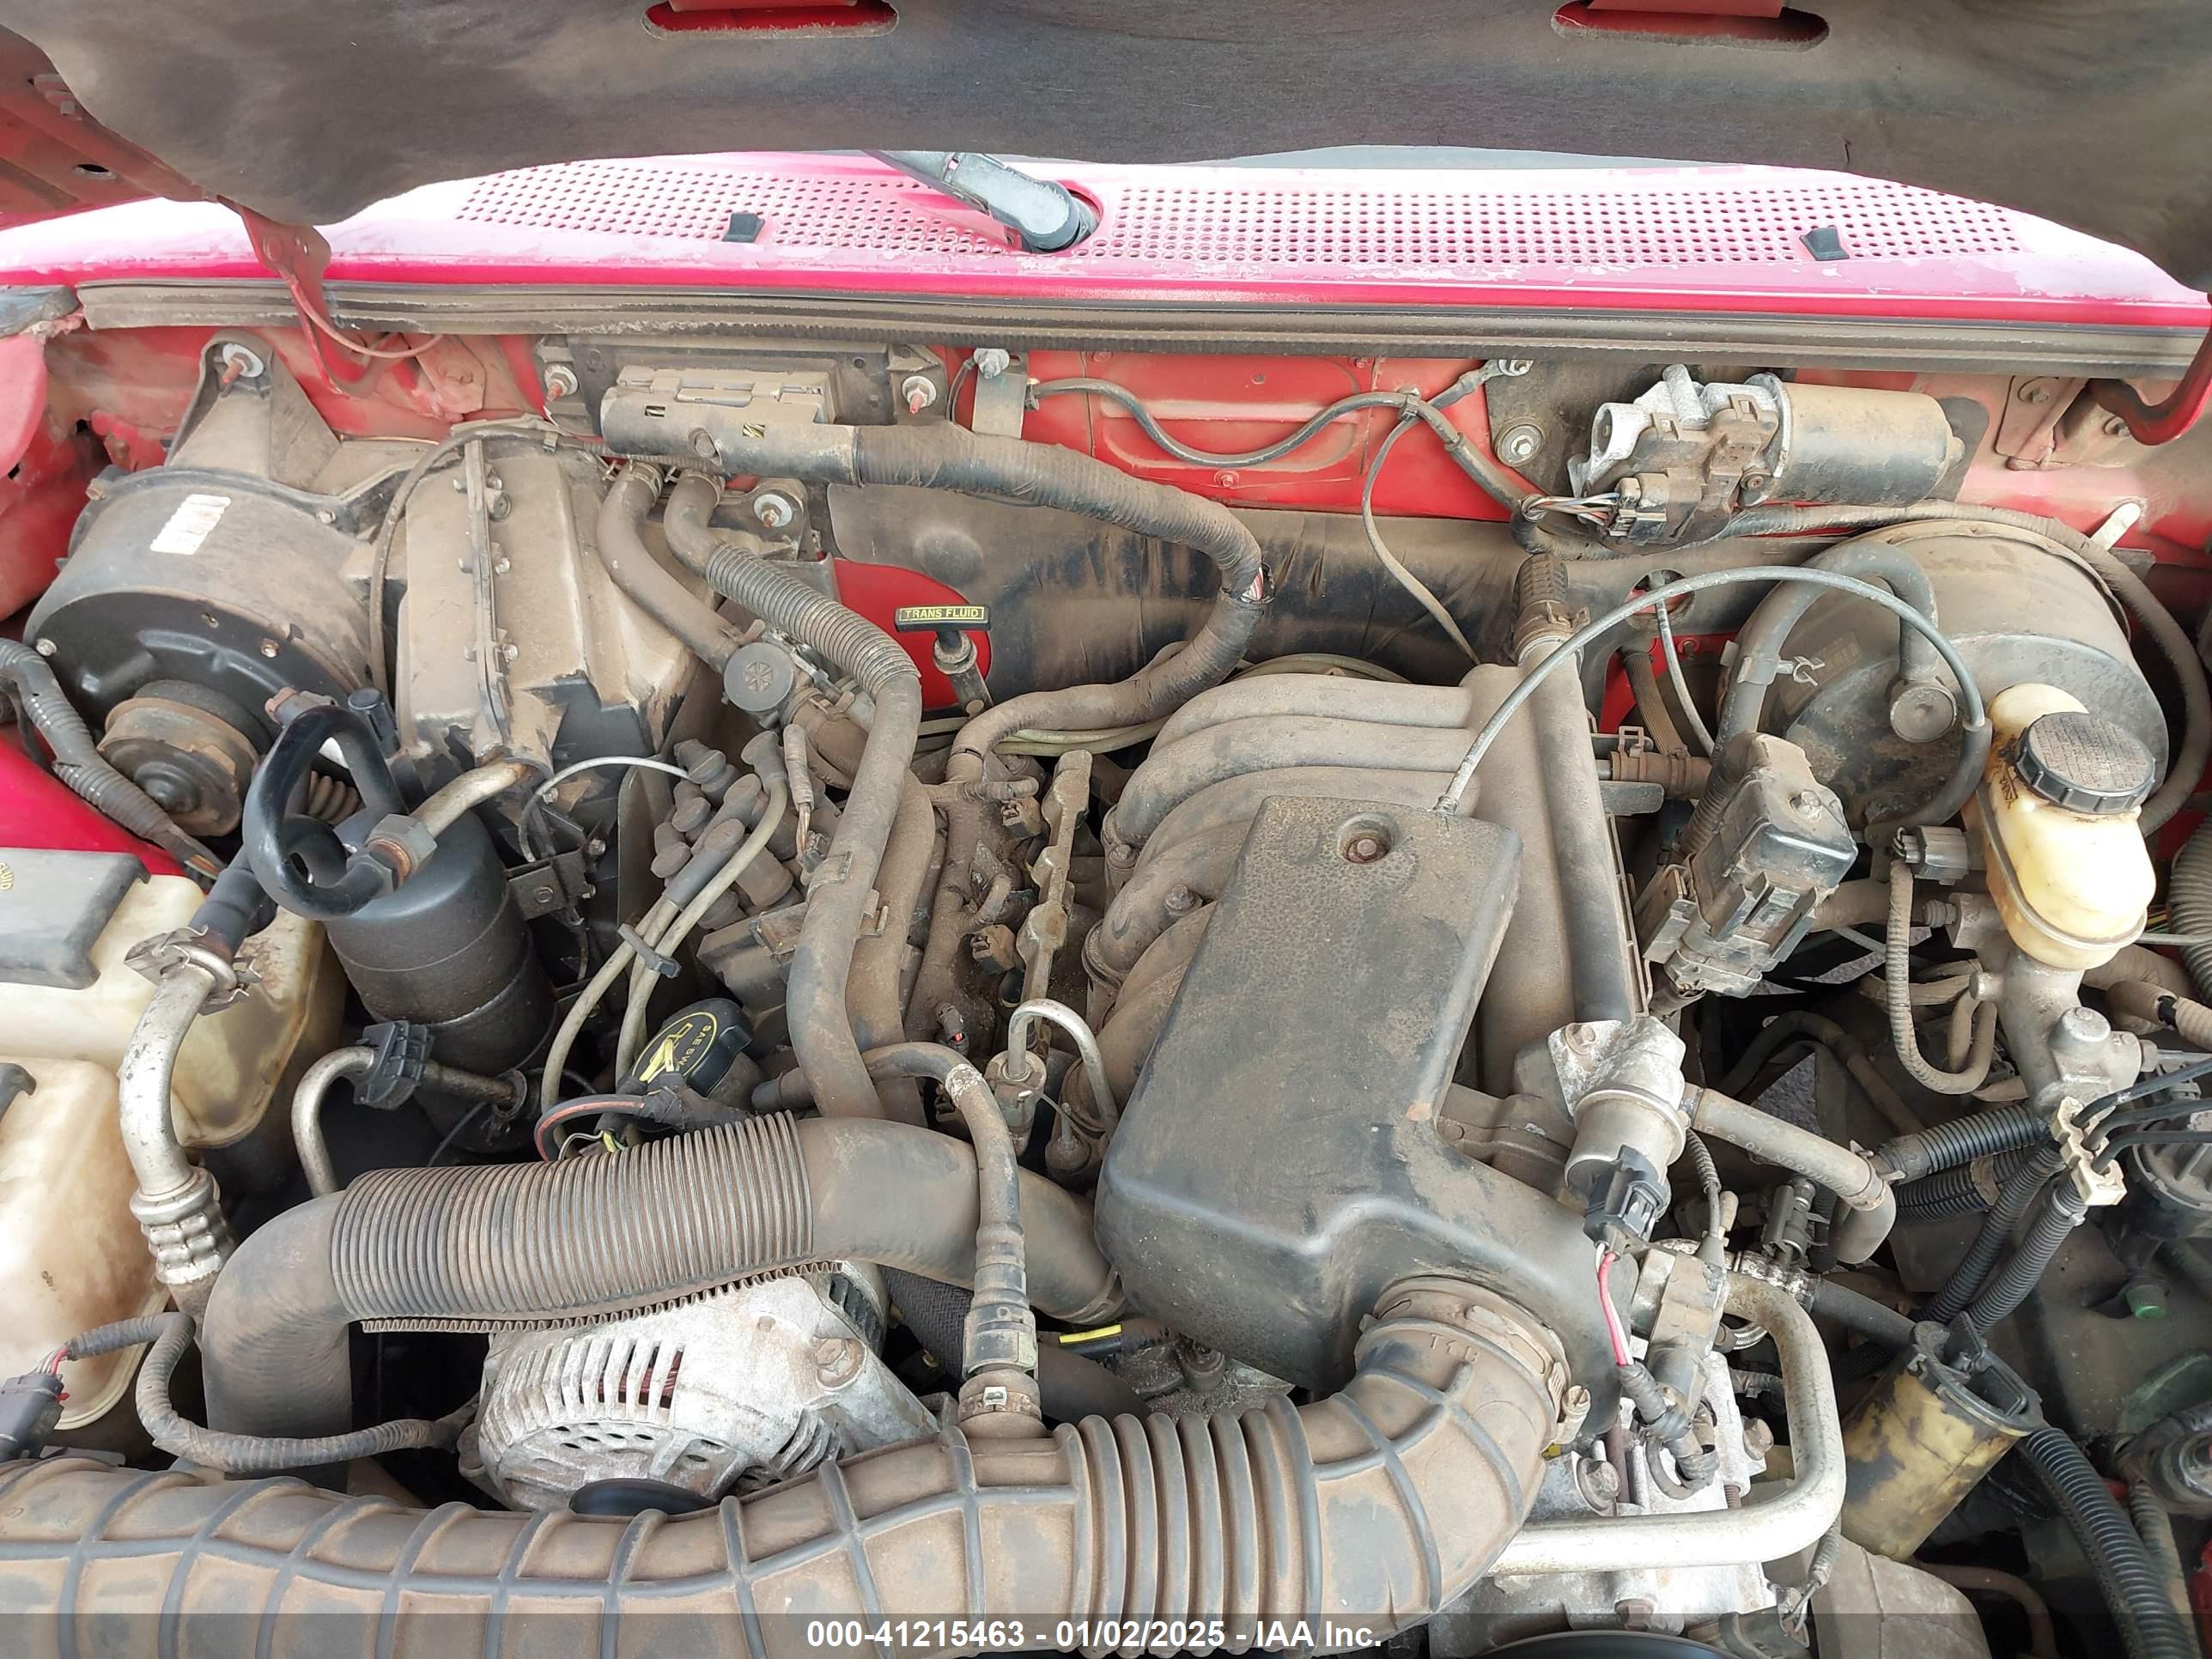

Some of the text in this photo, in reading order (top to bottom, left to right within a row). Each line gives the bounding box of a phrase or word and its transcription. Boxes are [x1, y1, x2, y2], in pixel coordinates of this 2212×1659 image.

[905, 607, 979, 619] TRANS FLUID
[691, 1024, 712, 1046] SAE
